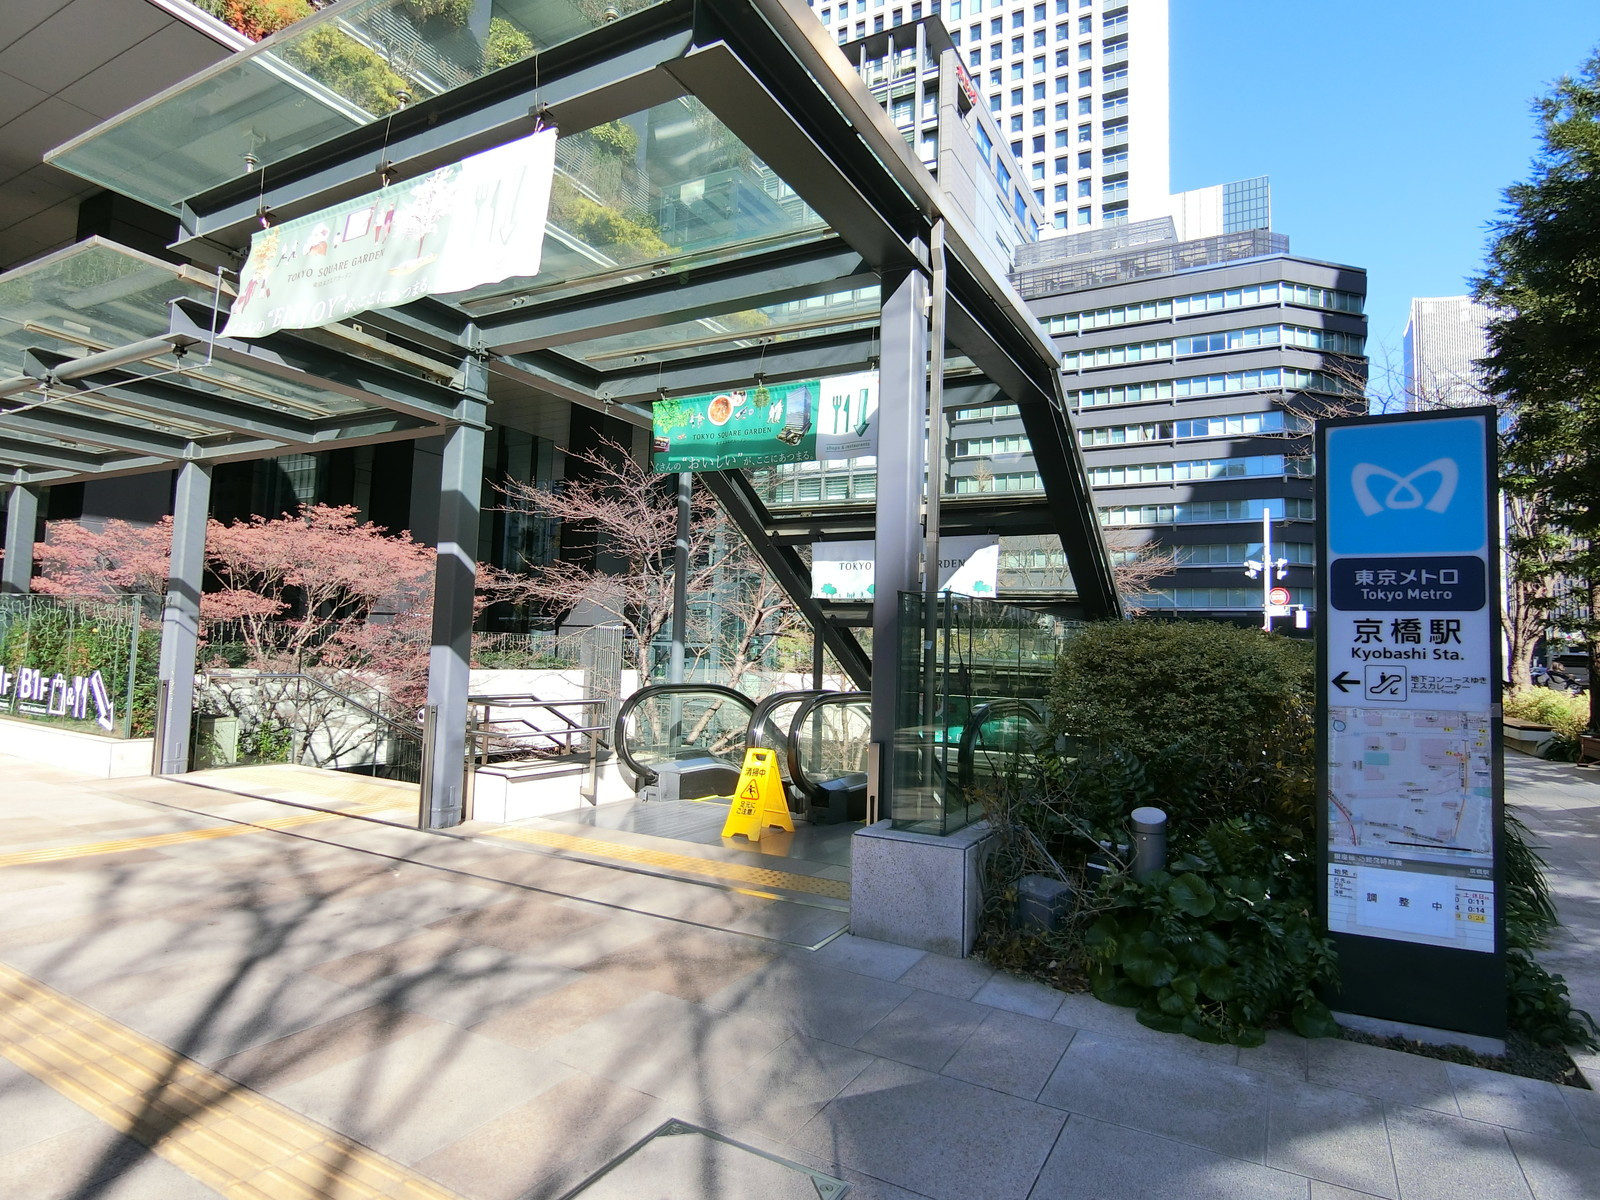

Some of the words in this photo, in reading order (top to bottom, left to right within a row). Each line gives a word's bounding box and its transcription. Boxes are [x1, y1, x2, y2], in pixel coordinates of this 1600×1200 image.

[287, 268, 313, 283] TOKYO
[318, 261, 348, 277] SQUARE
[351, 249, 386, 267] GARDEN
[693, 433, 715, 441] TOKYO
[717, 430, 742, 439] SQUARE
[744, 427, 772, 436] GARDEN
[839, 562, 872, 571] TOKYO
[937, 559, 965, 568] RDEN
[1354, 569, 1458, 585] 東京メトロ
[1361, 589, 1403, 602] Tokyo
[1407, 588, 1452, 600] Metro
[1353, 618, 1462, 645] 京橋駅
[1352, 648, 1426, 661] Kyobashi
[1433, 648, 1464, 660] Sta.
[20, 667, 50, 701] B1F
[1411, 675, 1487, 684] 地下コンコースゆき
[745, 768, 766, 777] 清掃中
